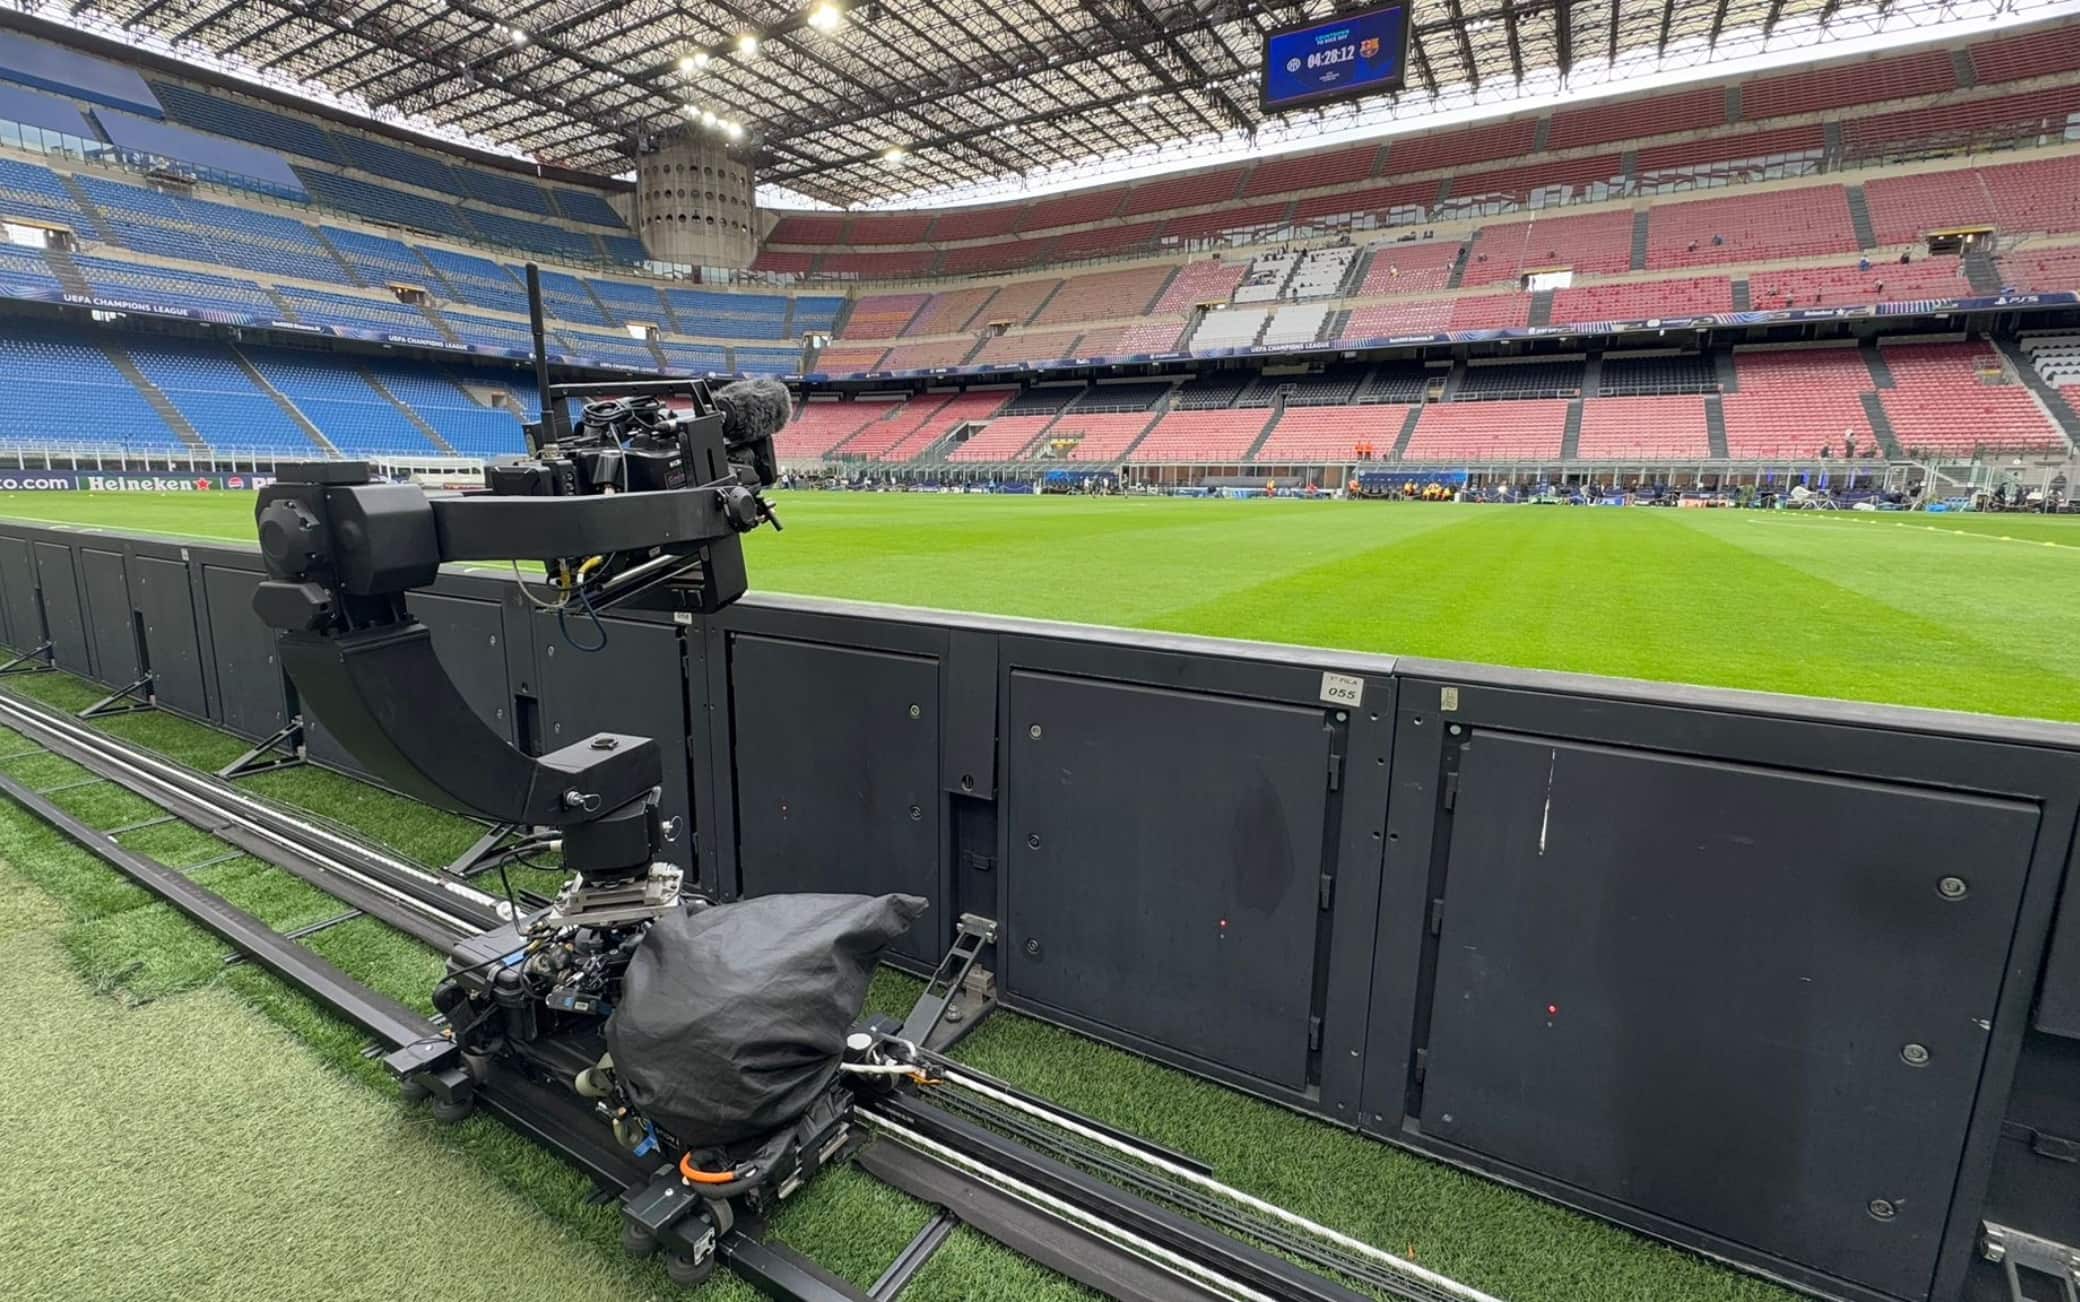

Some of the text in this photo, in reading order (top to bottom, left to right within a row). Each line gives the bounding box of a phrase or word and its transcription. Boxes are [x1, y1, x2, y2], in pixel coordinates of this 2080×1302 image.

[1307, 45, 1356, 69] 04:28:12
[64, 294, 188, 317] UEFA CHAMPIONS LEAGUE
[87, 476, 193, 491] Heineken
[1328, 687, 1357, 700] 055
